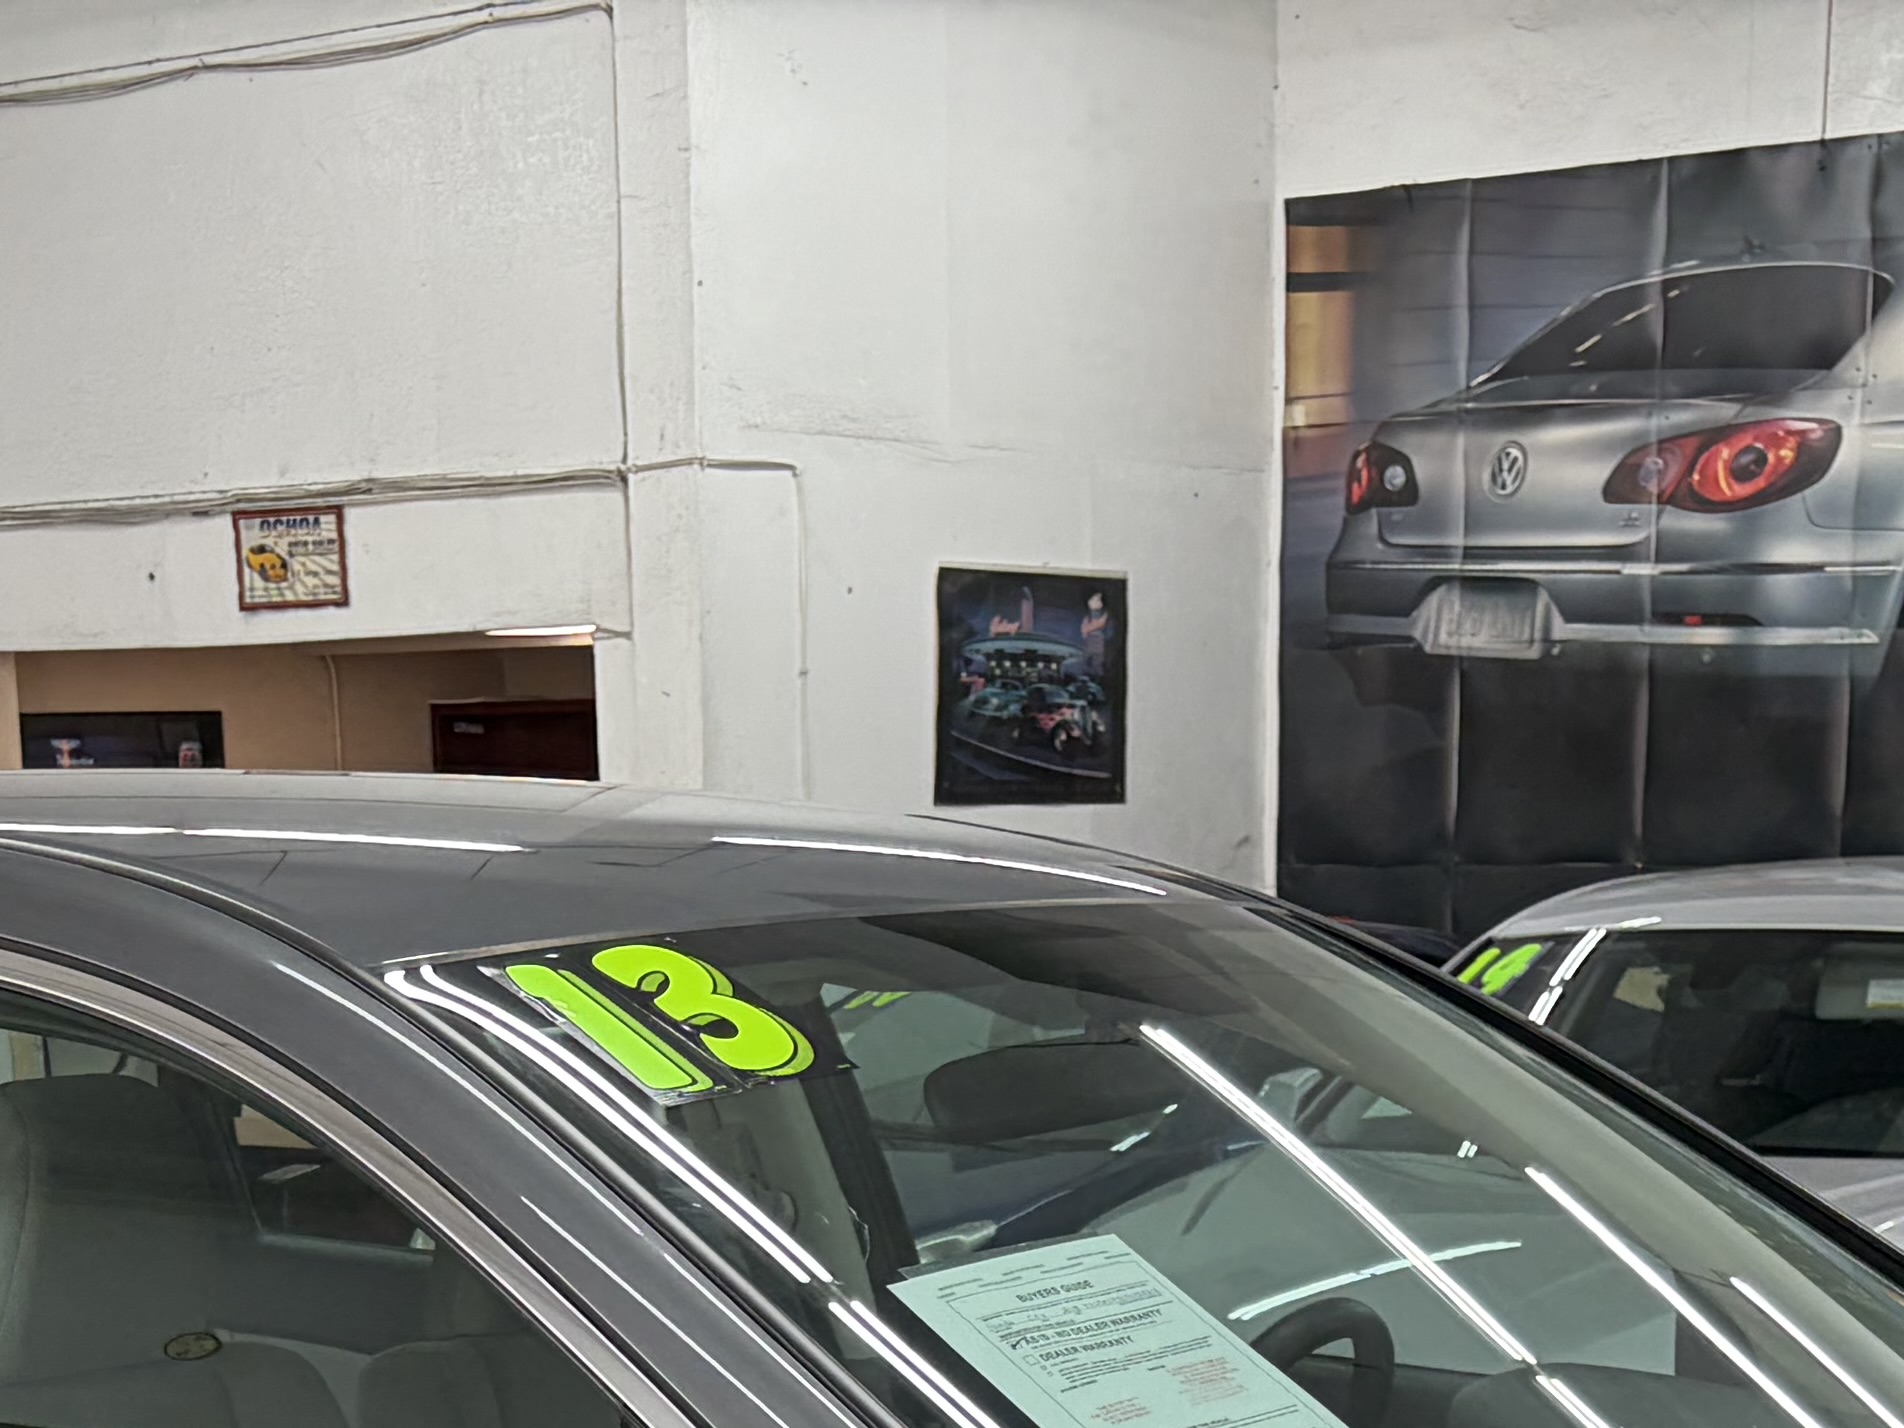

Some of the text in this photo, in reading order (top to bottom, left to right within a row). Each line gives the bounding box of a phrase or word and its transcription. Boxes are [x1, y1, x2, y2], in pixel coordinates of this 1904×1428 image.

[505, 944, 814, 1093] 13
[1016, 1279, 1094, 1302] BUYERS GUIDE
[1070, 1318, 1109, 1336] DEALER
[1109, 1308, 1162, 1327] WARRANTY
[1039, 1335, 1134, 1362] DEALER WARRANTY
